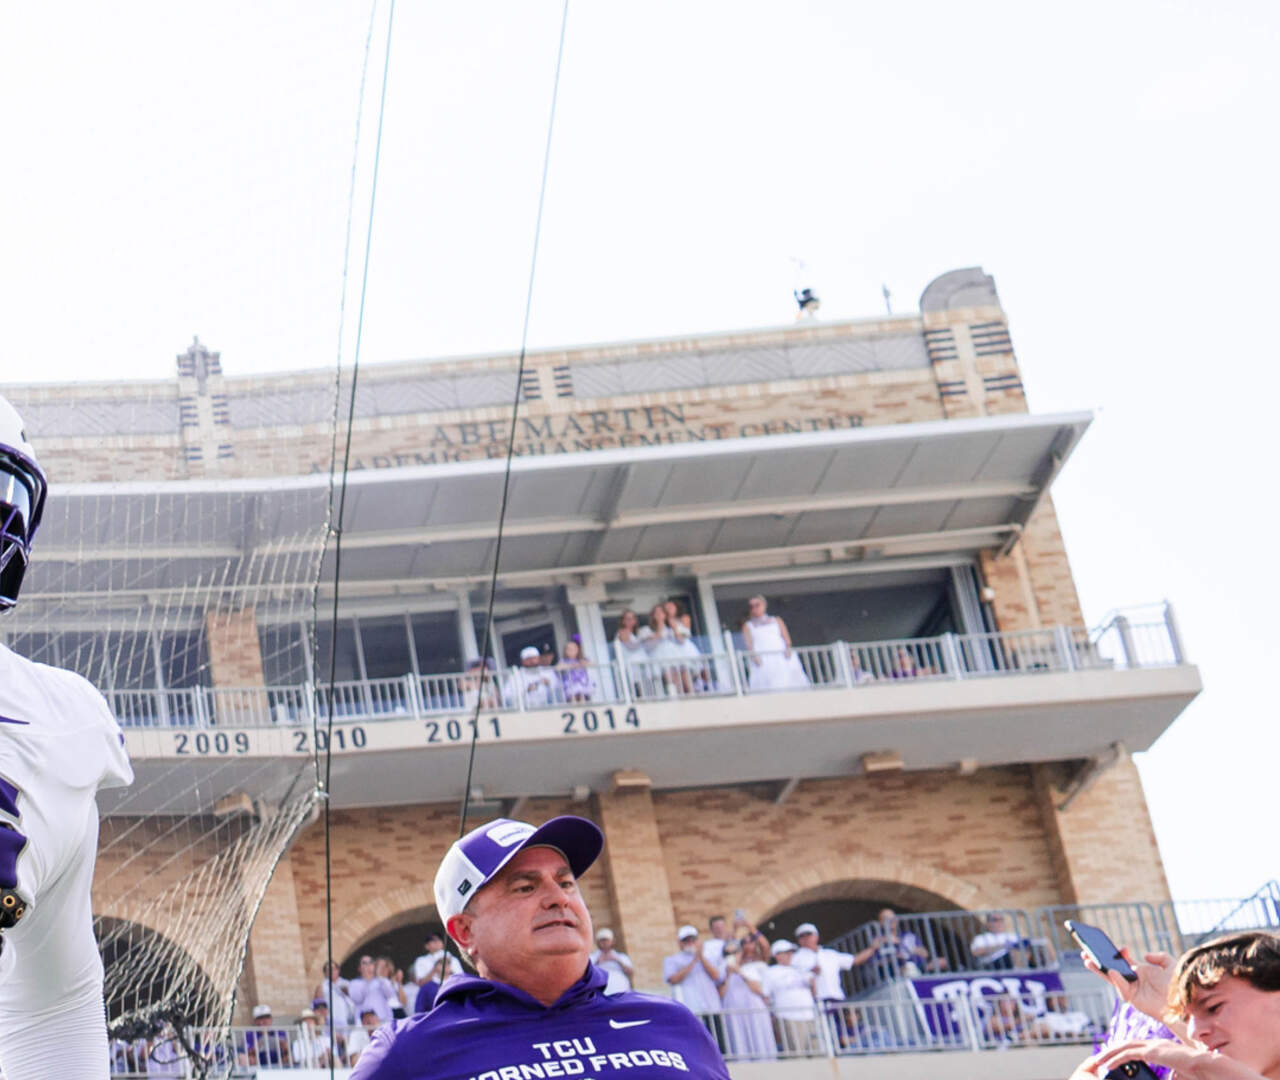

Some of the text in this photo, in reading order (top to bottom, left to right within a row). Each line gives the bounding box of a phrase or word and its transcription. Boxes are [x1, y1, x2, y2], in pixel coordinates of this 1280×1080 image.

[429, 404, 688, 447] ABE MARTIN
[738, 414, 867, 435] CENTER
[175, 706, 642, 755] 2009 2010 2011 2014
[931, 977, 1047, 1024] TCU
[532, 1037, 597, 1060] TCU
[589, 1050, 688, 1072] FROGS
